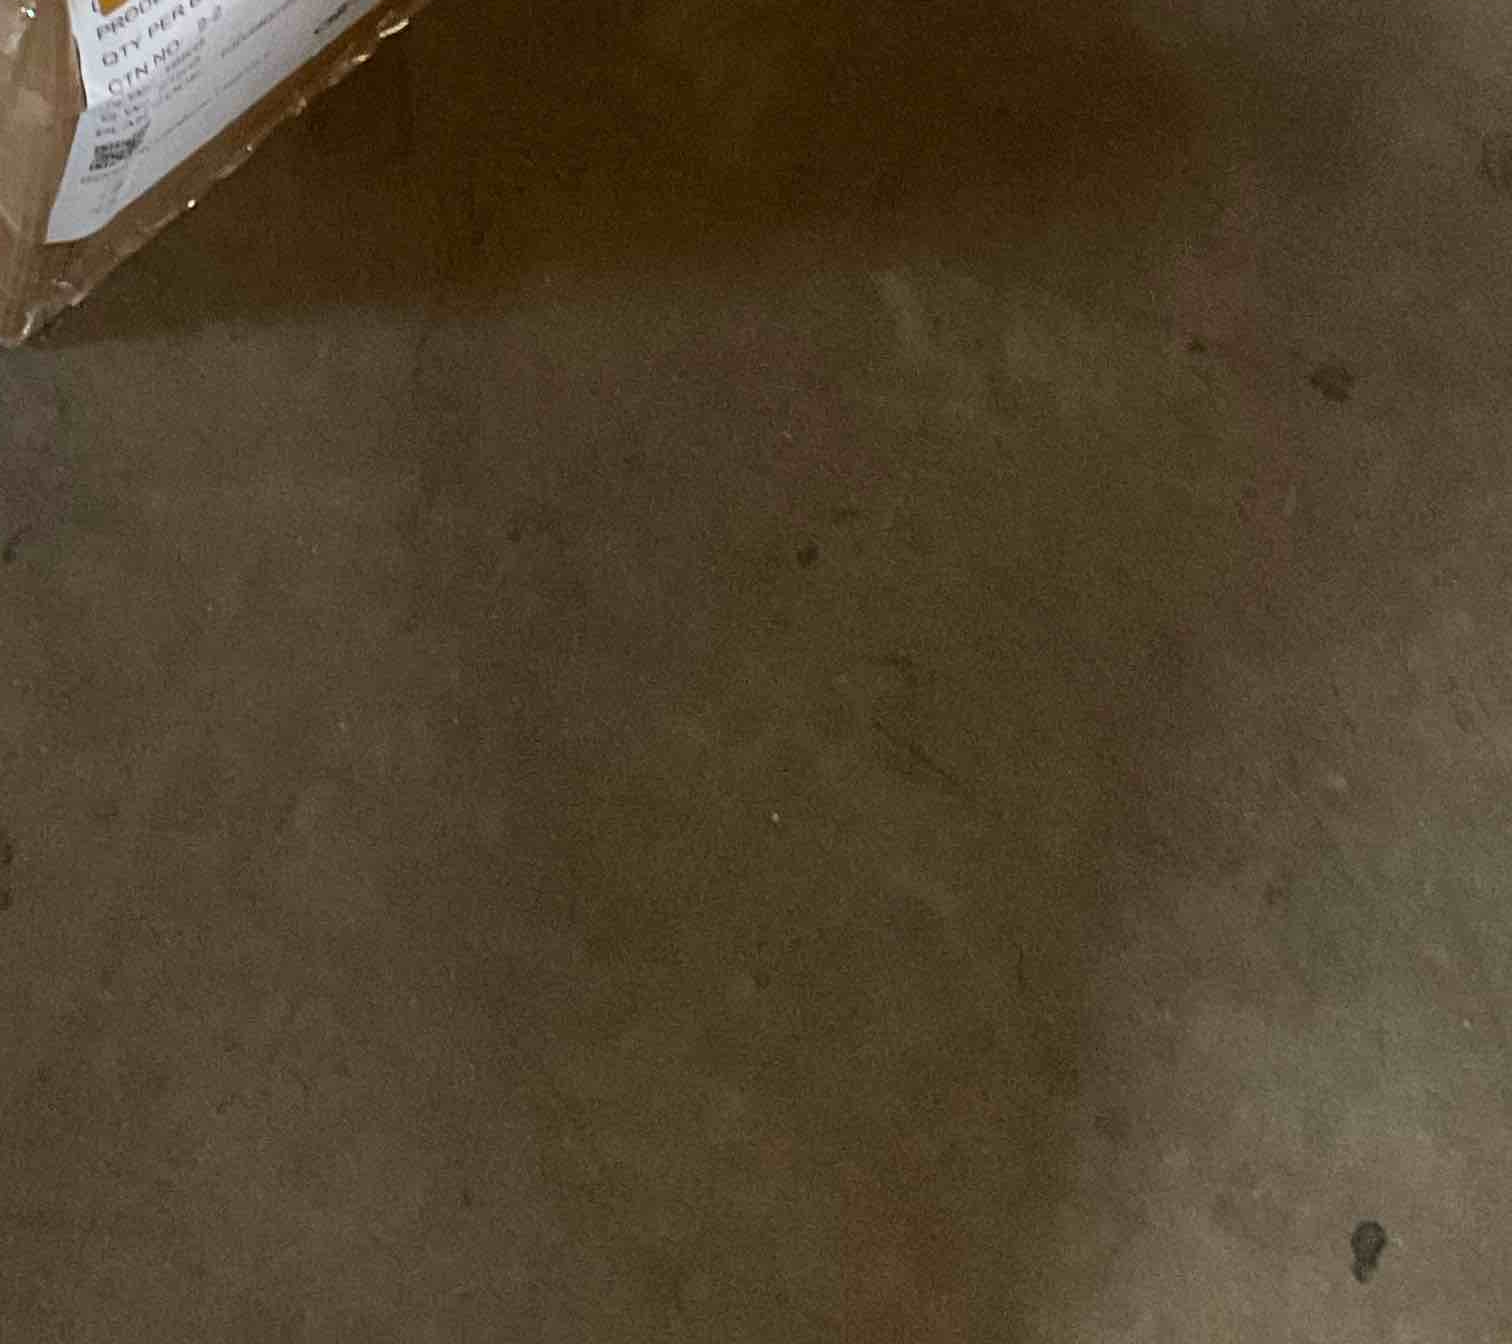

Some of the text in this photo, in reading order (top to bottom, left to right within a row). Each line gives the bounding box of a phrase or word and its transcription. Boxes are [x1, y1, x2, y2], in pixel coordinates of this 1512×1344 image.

[102, 37, 141, 67] QTY
[148, 3, 185, 39] PER
[108, 63, 149, 96] CTN
